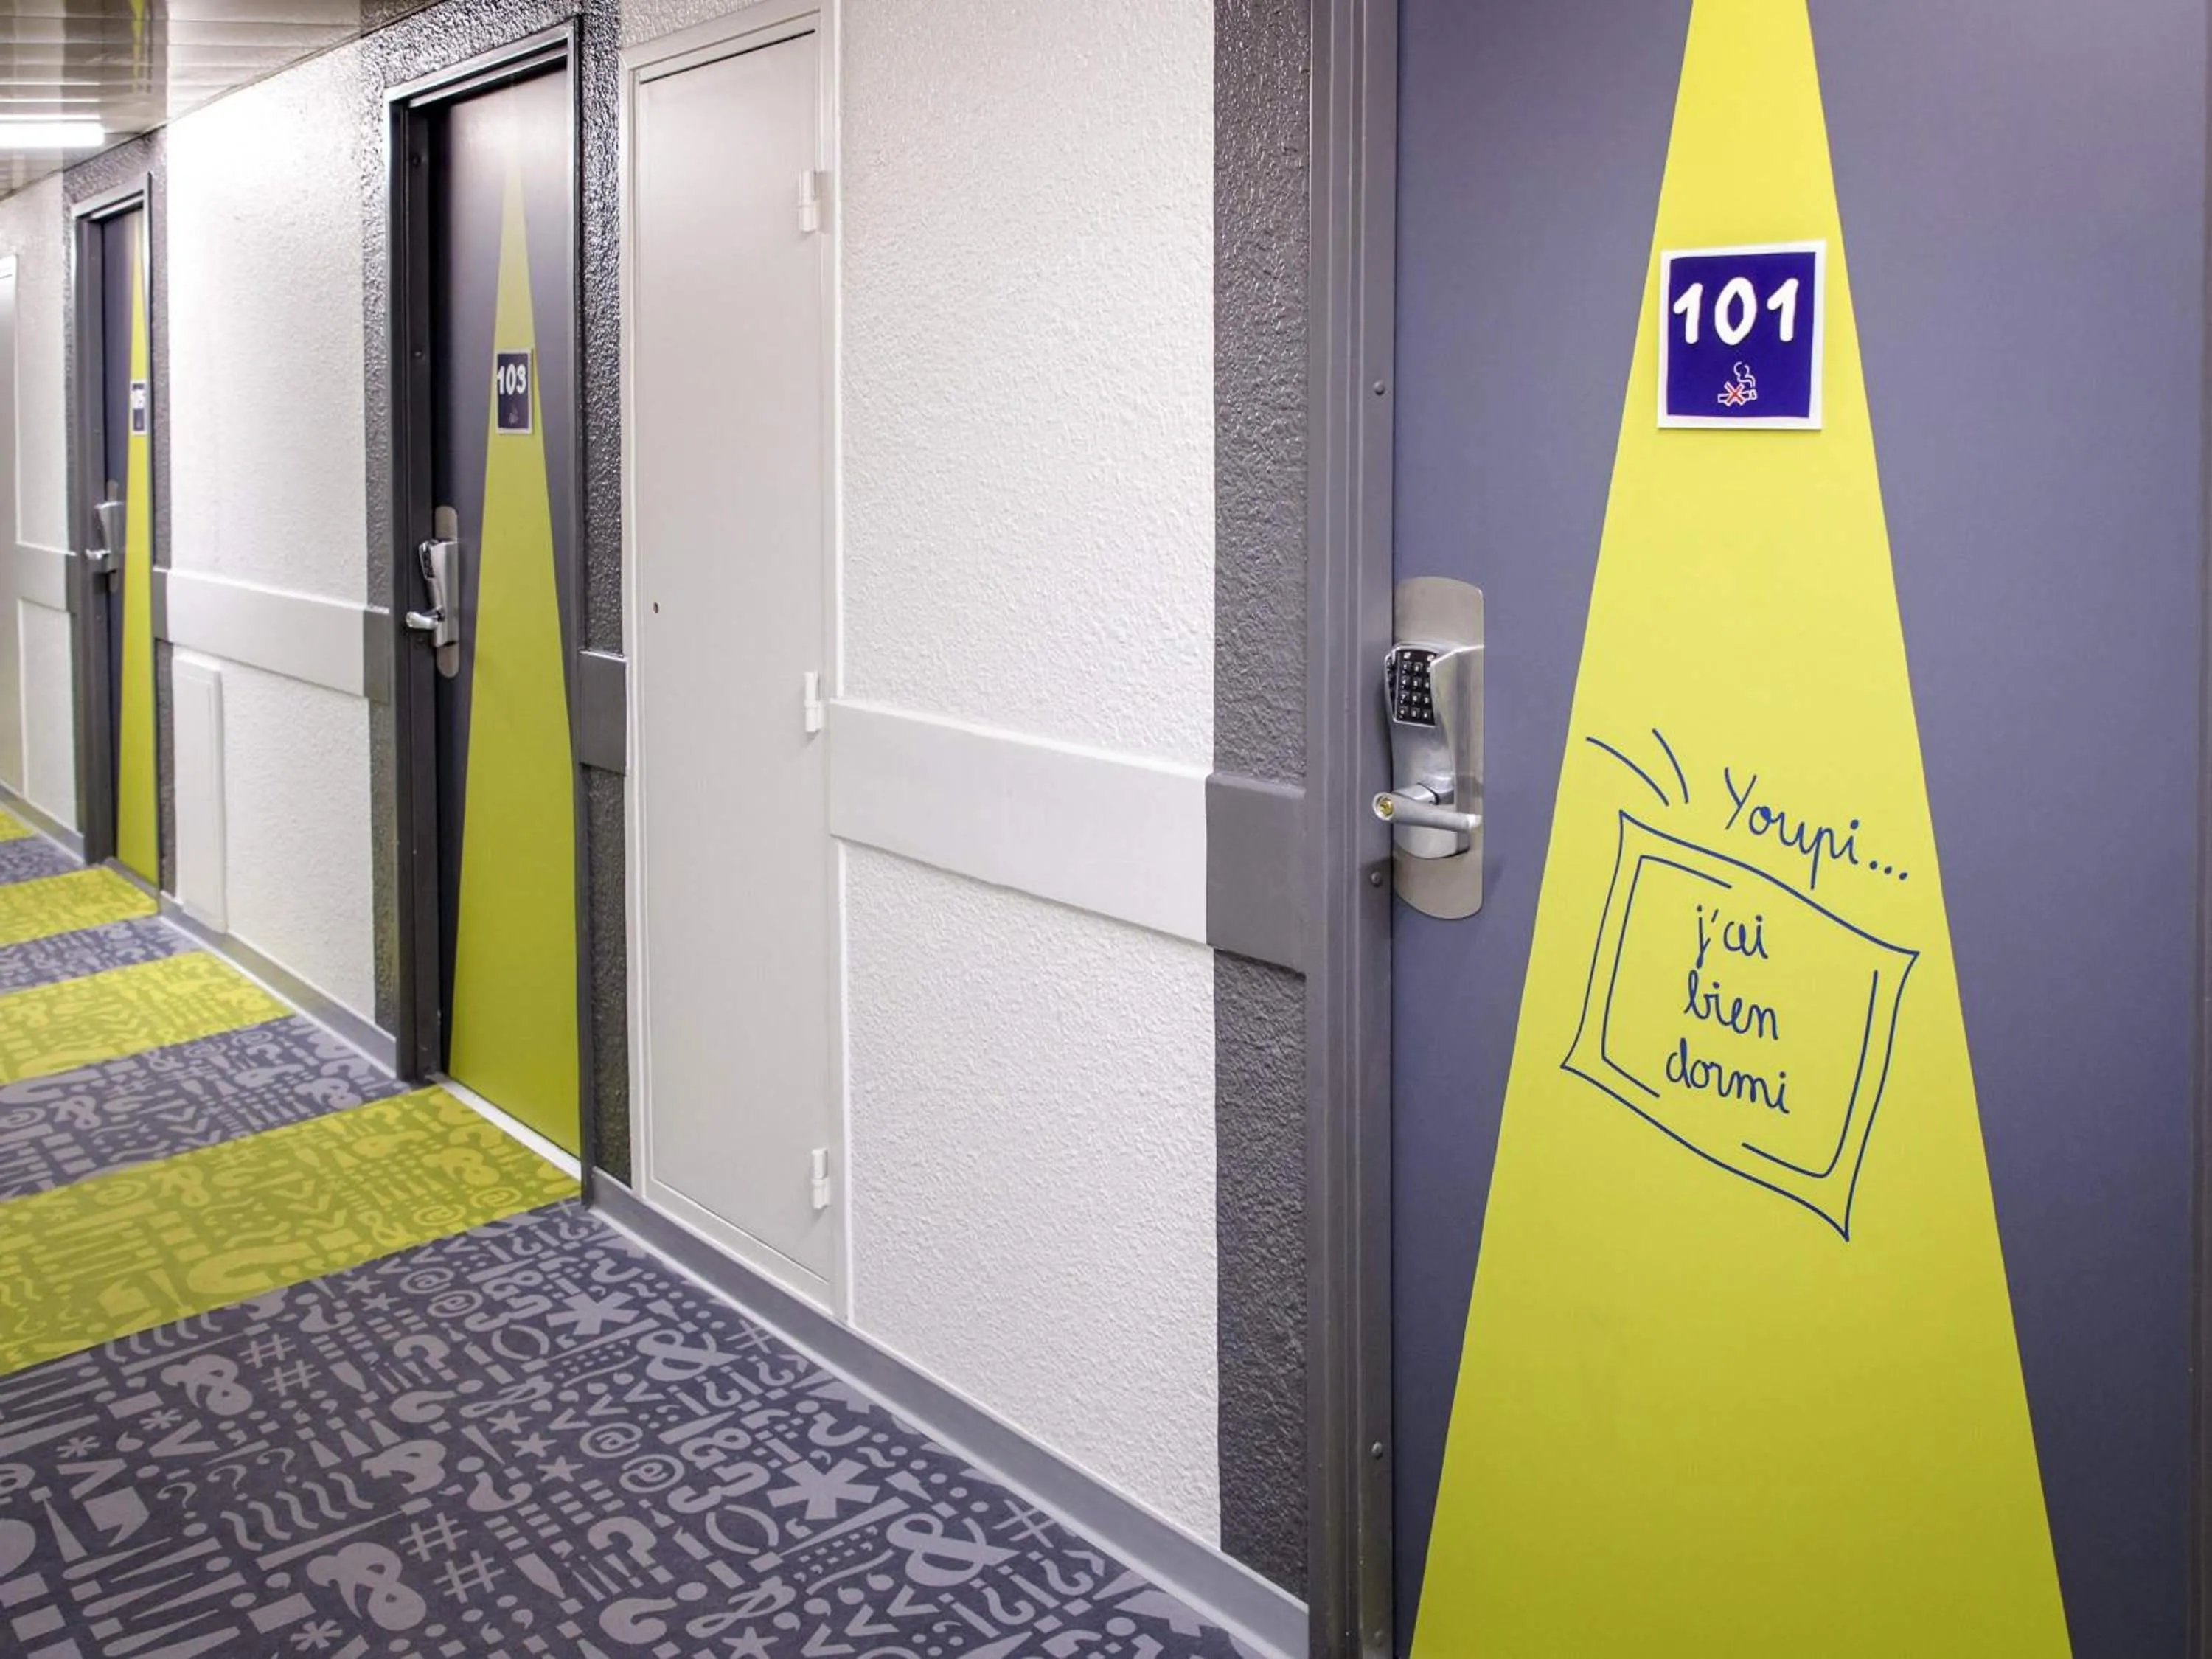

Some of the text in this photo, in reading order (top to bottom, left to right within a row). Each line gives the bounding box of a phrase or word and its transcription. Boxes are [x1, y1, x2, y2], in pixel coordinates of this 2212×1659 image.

[1673, 276, 1799, 346] 101
[497, 364, 526, 395] 103
[1723, 766, 1909, 891] Youpi...
[1695, 904, 1769, 970] j'ai
[1683, 968, 1779, 1041] bien
[1666, 1037, 1790, 1115] dormi
